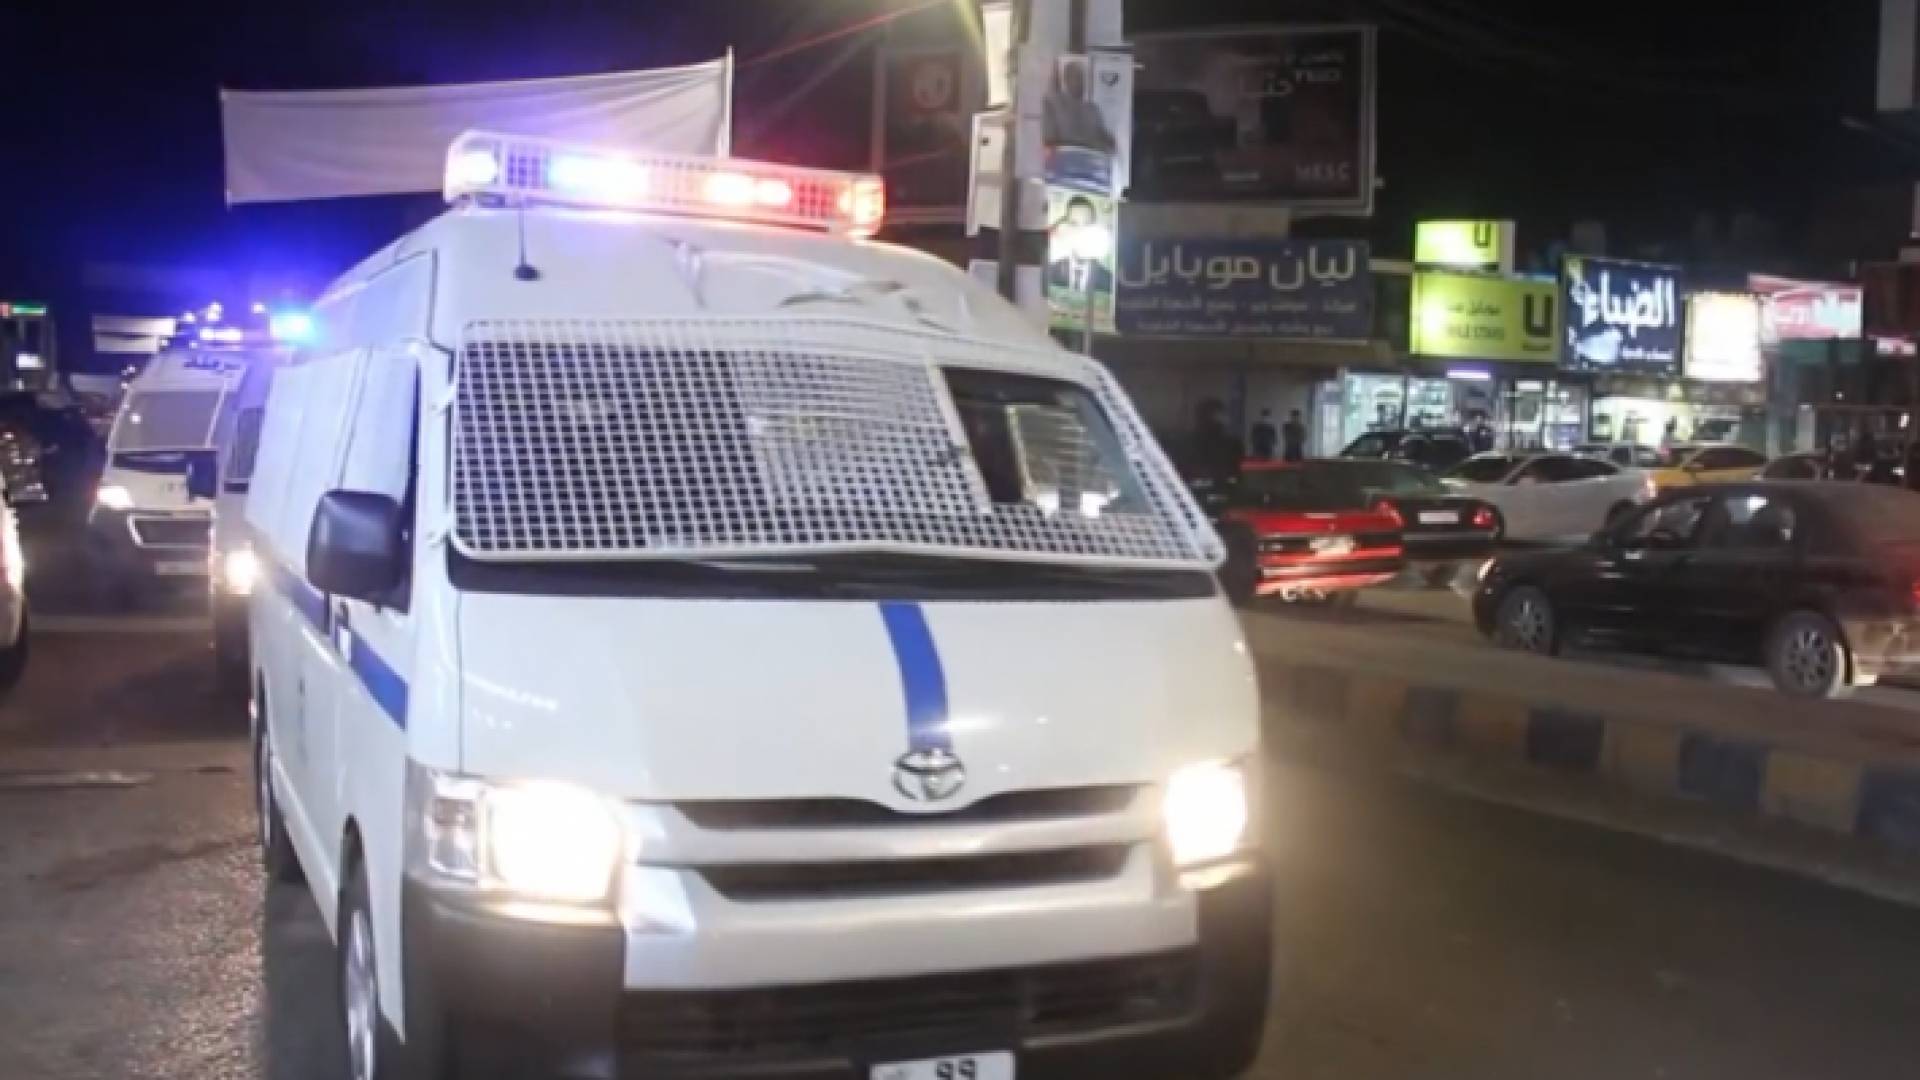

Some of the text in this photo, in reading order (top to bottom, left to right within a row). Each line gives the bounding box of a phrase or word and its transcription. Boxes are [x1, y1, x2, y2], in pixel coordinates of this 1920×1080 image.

[1118, 242, 1357, 290] ليان موبايل
[1523, 294, 1554, 337] U
[1583, 270, 1675, 338] الضياء
